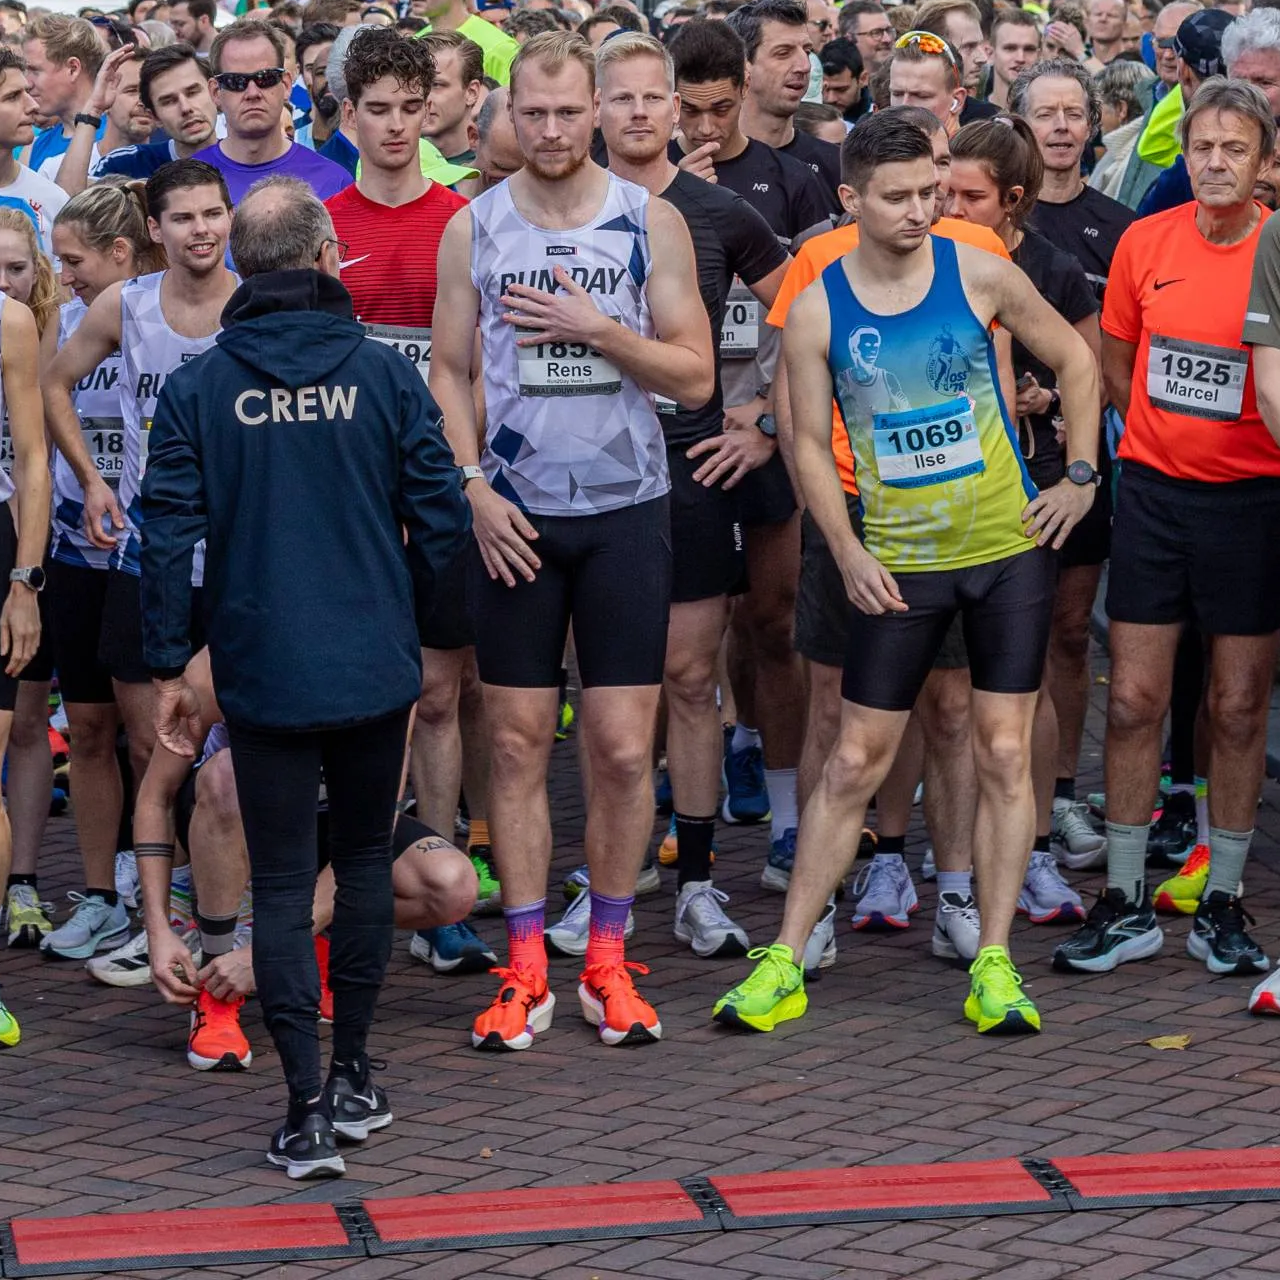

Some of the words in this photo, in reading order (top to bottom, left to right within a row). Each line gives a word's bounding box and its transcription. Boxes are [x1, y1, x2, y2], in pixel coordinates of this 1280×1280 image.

[547, 362, 592, 377] Rens
[949, 371, 968, 383] OSS
[1161, 353, 1231, 386] 1925
[1165, 379, 1219, 402] Marcel
[234, 385, 357, 425] CREW
[888, 420, 963, 454] 1069
[915, 453, 946, 469] Ilse
